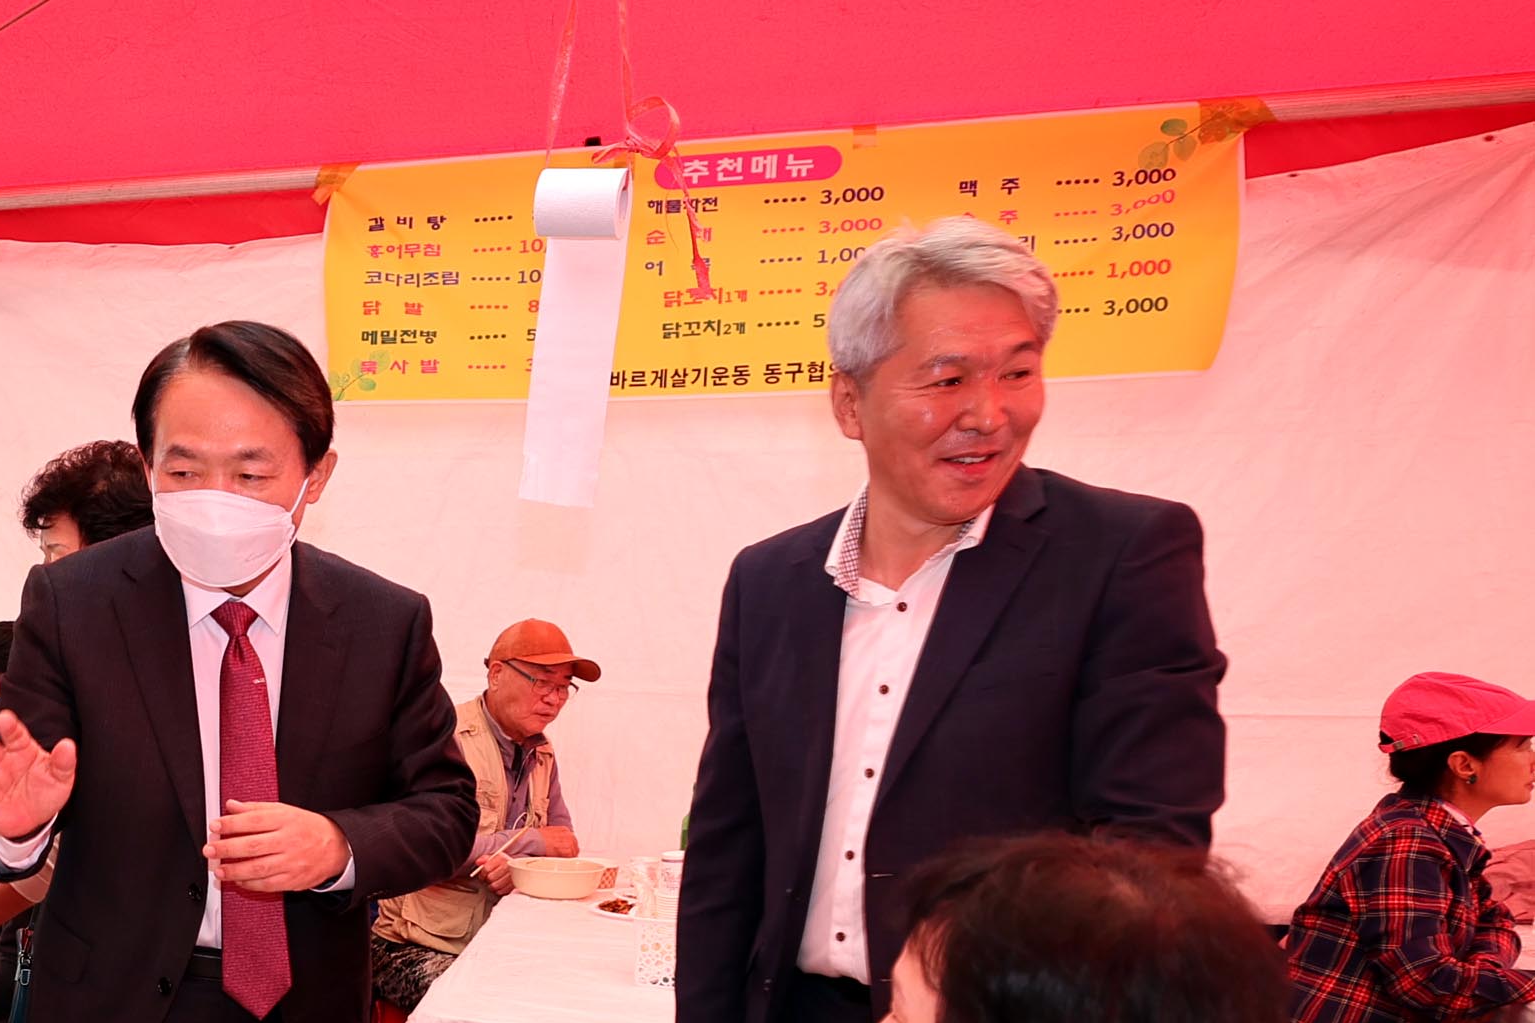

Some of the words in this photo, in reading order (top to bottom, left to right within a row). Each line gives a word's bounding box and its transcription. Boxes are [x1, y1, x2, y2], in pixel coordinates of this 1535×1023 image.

[681, 154, 815, 184] 추천메뉴
[1111, 168, 1177, 187] 3,000
[819, 186, 885, 205] 3,000
[1109, 189, 1176, 217] 3,000
[818, 217, 883, 234] 3,000
[1110, 222, 1175, 242] 3,000
[366, 243, 441, 259] 홍어무침
[817, 247, 866, 264] 1,00
[1105, 258, 1172, 279] 1,000
[364, 271, 460, 288] 코다리조림
[1102, 297, 1169, 316] 3,000
[361, 329, 438, 345] 메밀전병
[610, 365, 751, 389] 바르게살기운동
